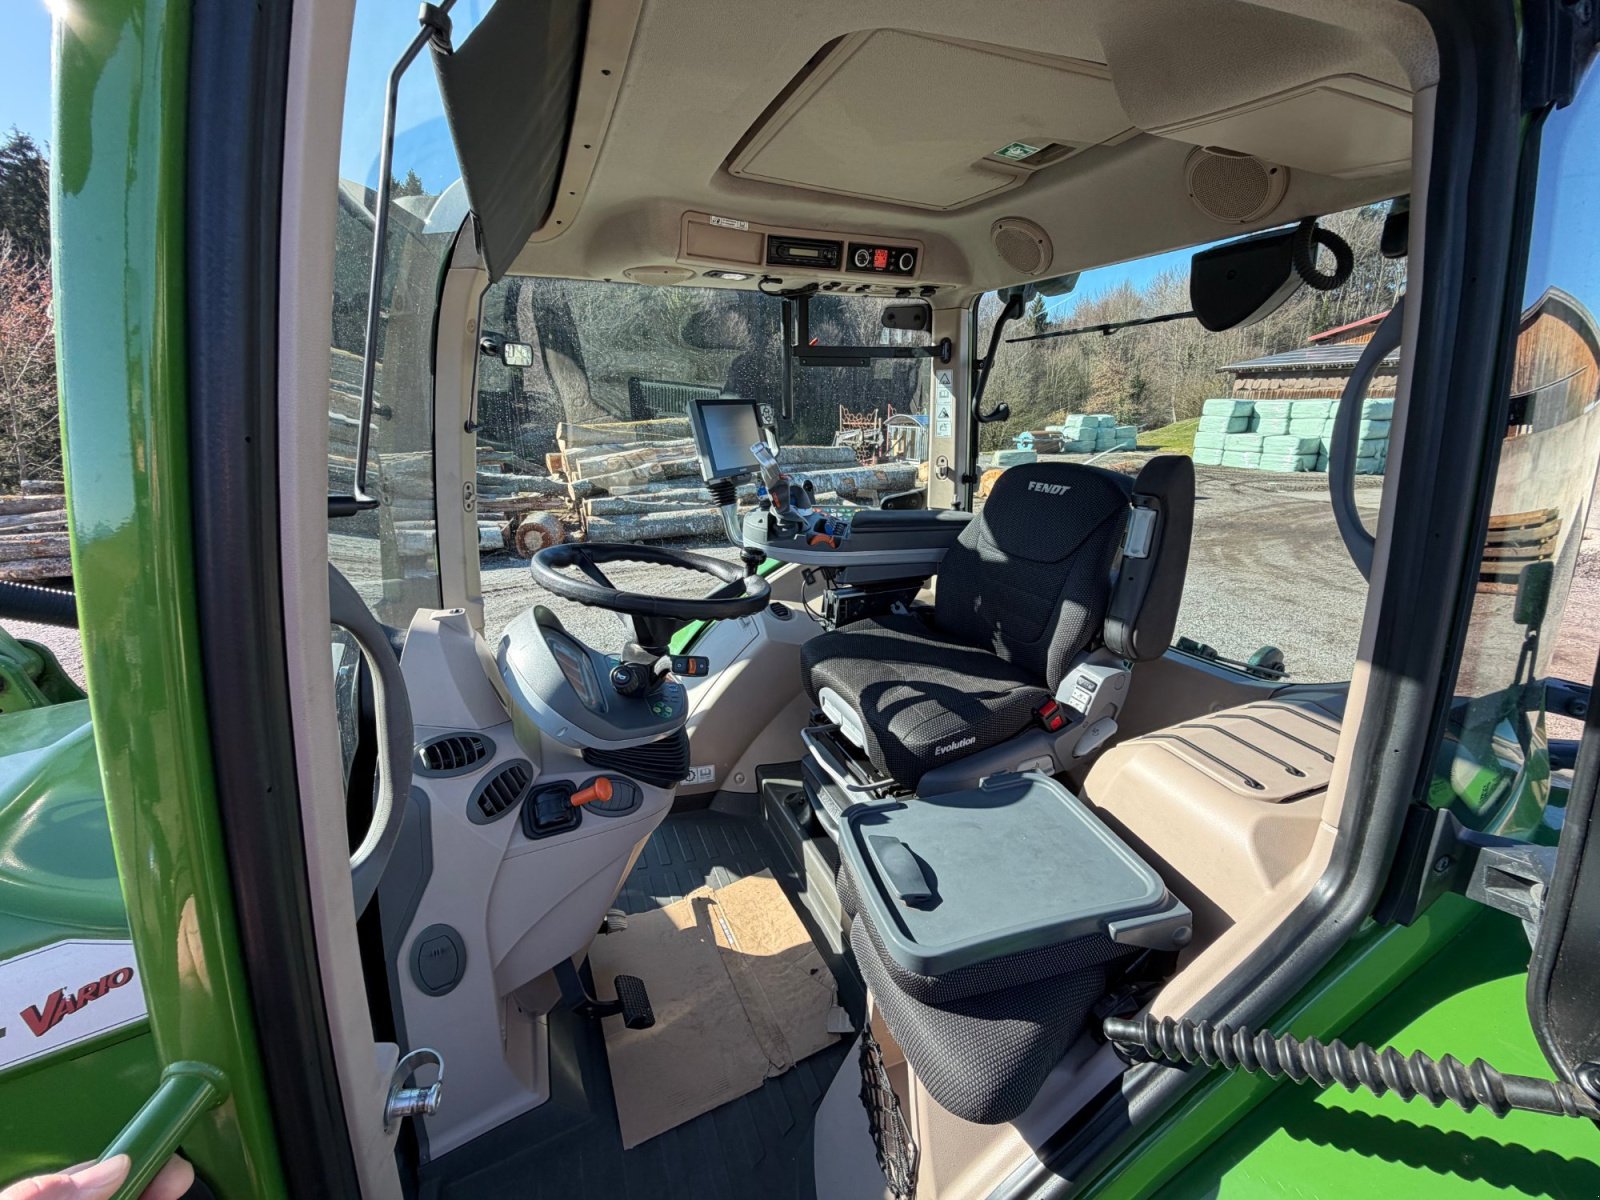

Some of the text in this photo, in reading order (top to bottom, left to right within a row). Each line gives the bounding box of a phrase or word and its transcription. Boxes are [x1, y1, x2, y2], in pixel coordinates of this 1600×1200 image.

[1028, 481, 1071, 496] FENDT
[935, 736, 976, 756] Evolution
[20, 967, 134, 1037] VARIO
